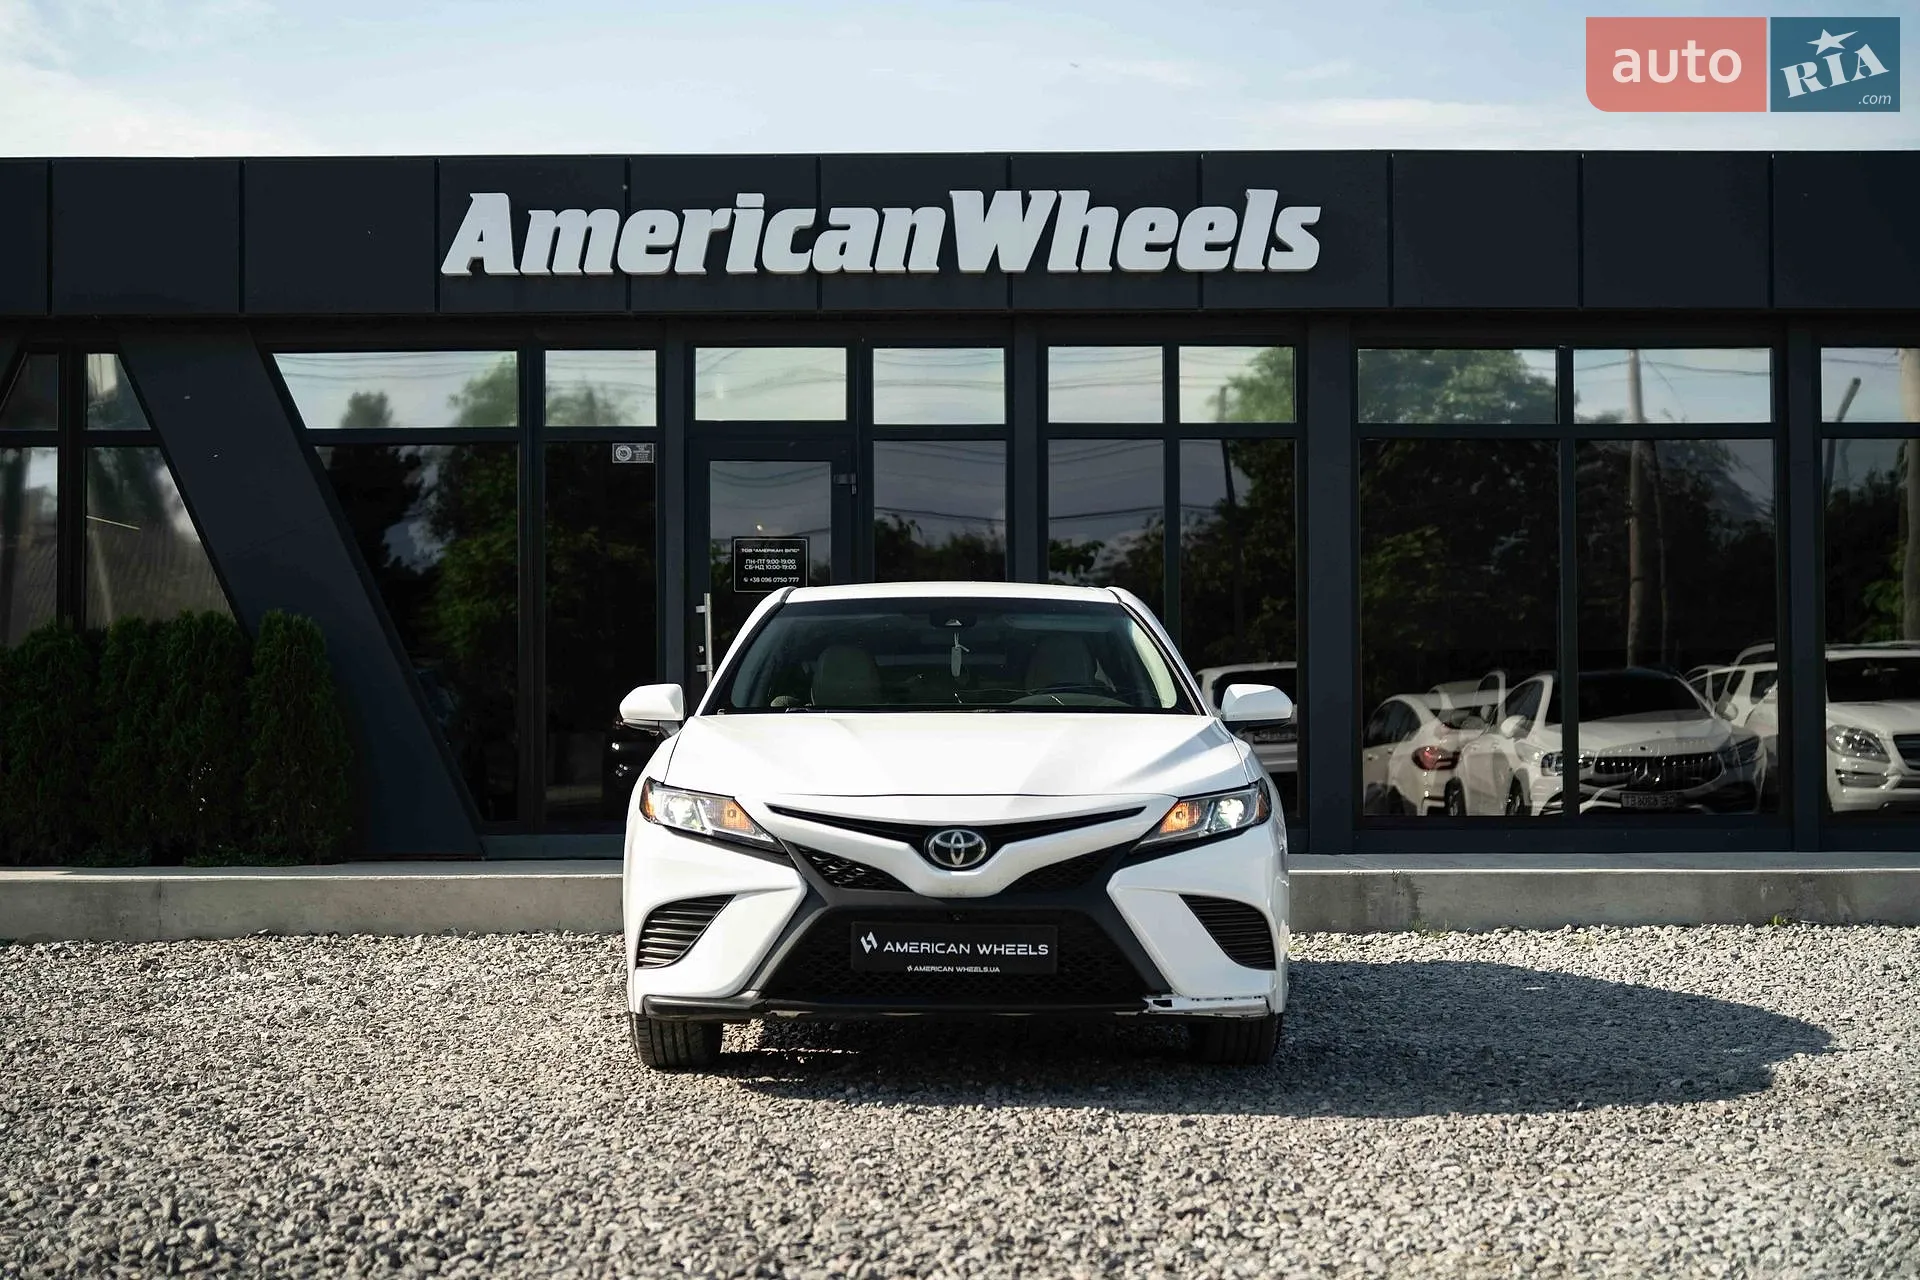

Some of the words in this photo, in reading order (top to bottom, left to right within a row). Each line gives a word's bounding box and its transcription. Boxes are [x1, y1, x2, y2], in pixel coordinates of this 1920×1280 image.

[441, 189, 1321, 276] AmericanWheels
[883, 942, 970, 954] AMERICAN
[976, 944, 1049, 956] WHEELS
